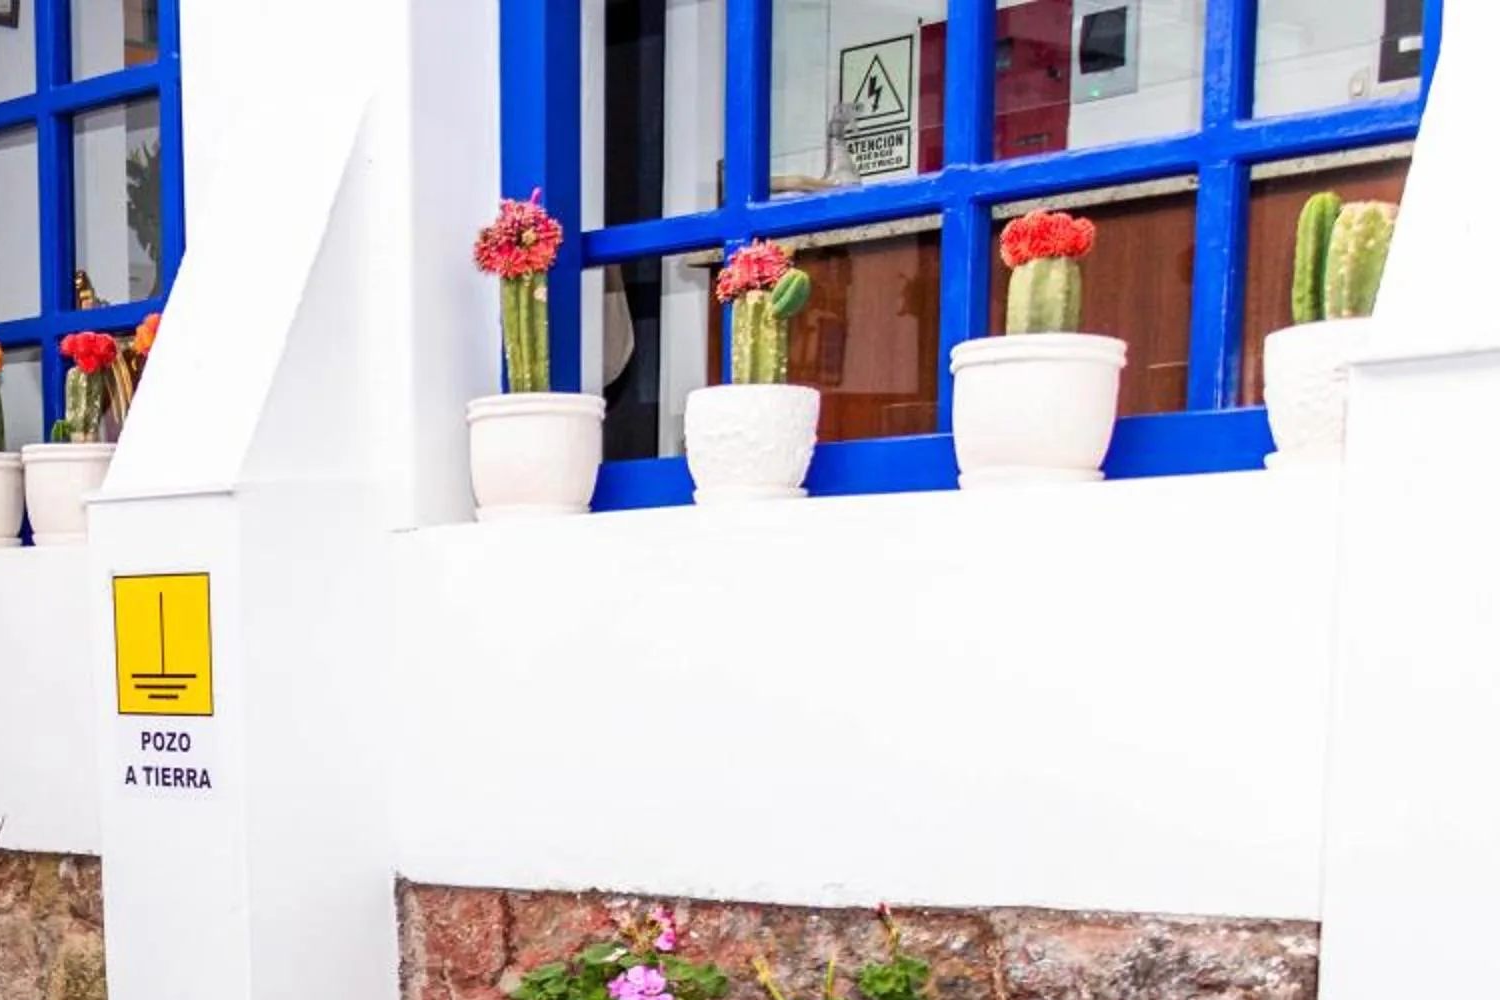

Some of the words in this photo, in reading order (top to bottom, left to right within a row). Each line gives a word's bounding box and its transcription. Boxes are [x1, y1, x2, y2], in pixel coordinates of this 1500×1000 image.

[847, 133, 904, 154] ATENCION
[141, 731, 191, 752] POZO
[125, 765, 137, 785] A
[142, 766, 212, 788] TIERRA
